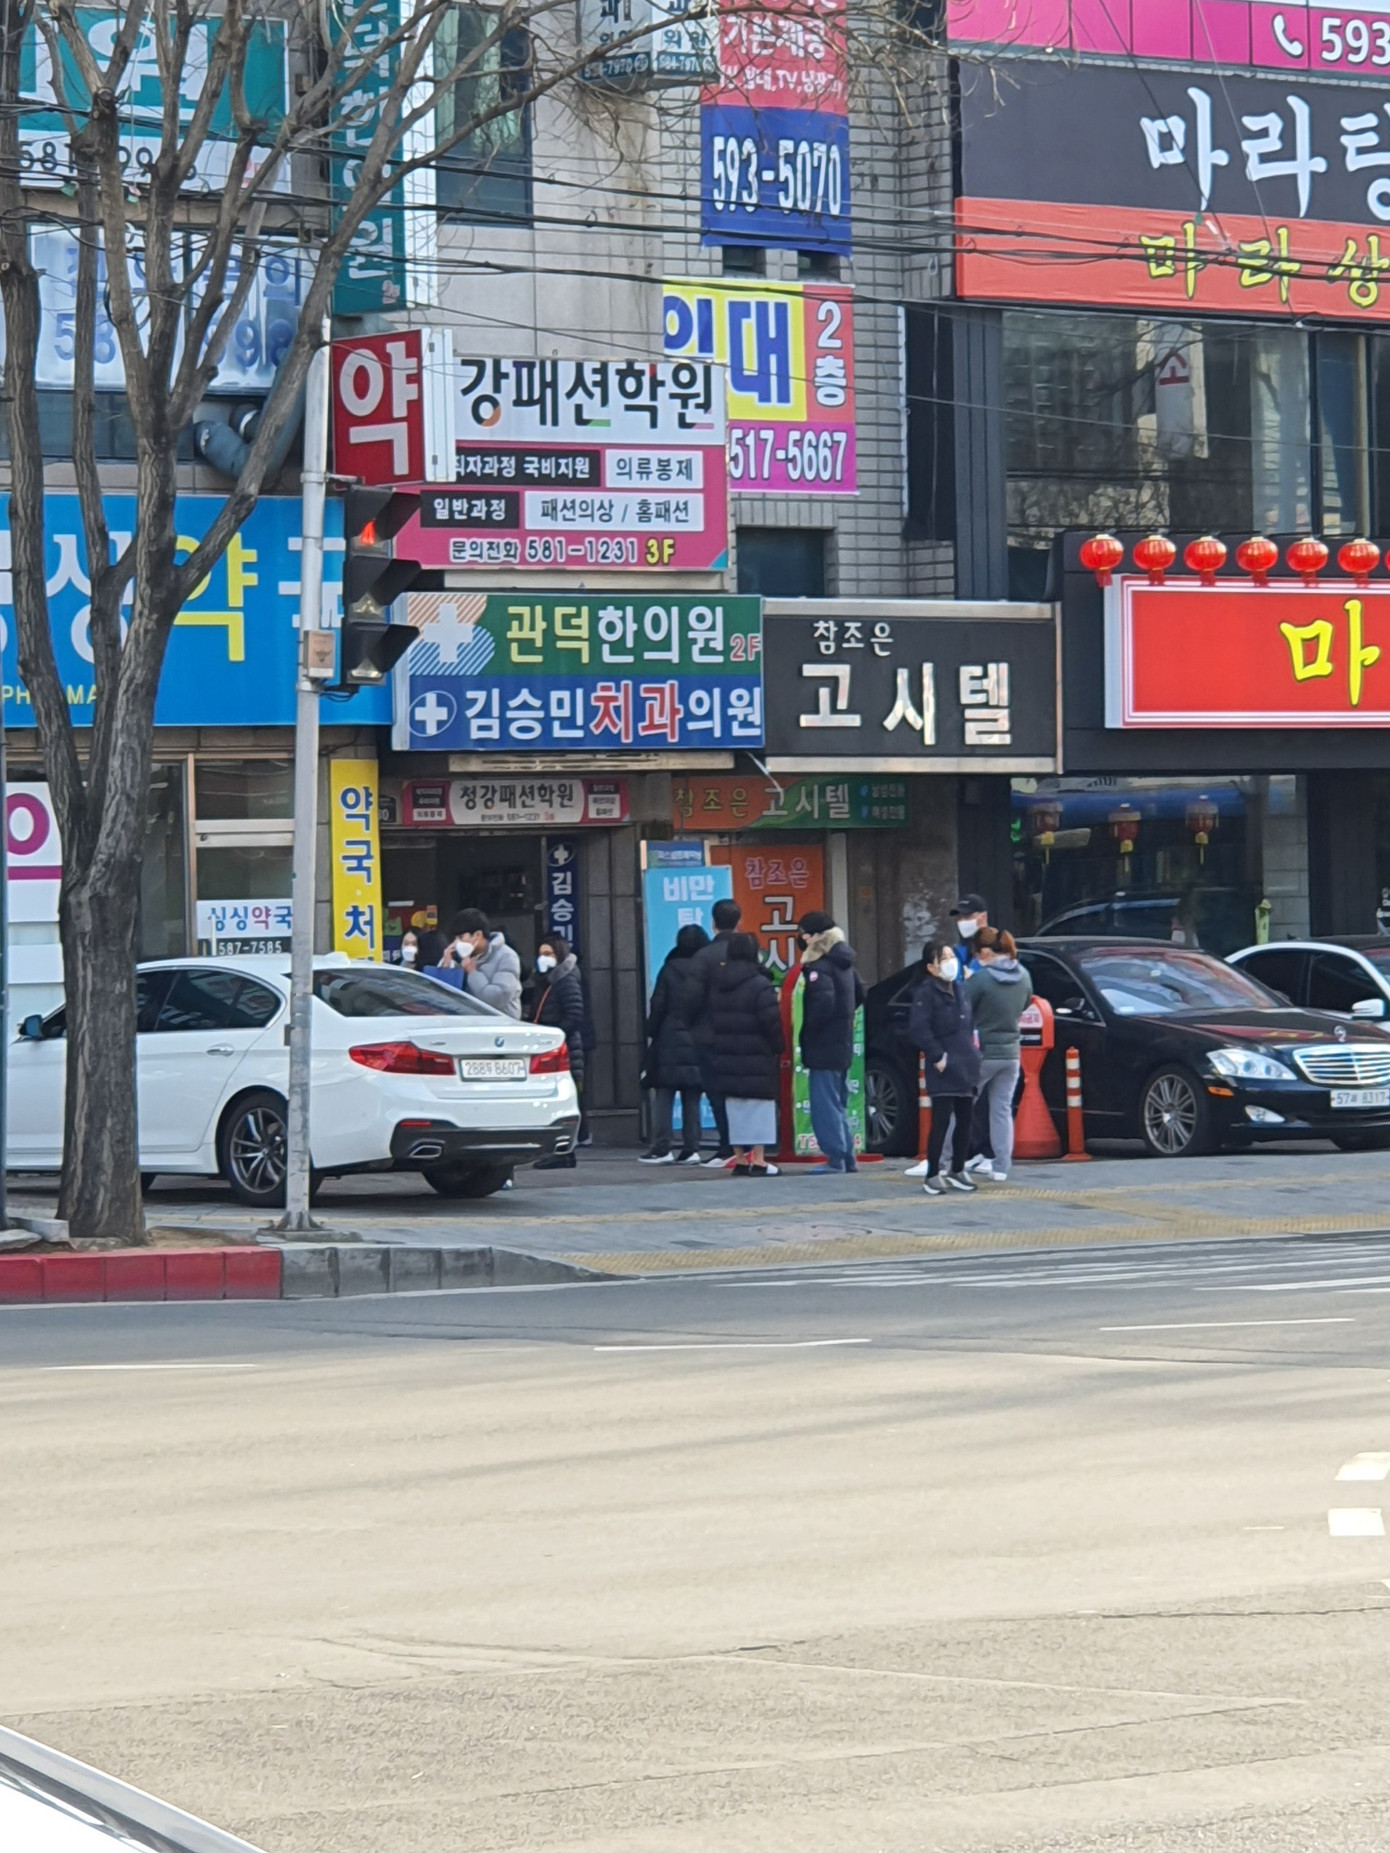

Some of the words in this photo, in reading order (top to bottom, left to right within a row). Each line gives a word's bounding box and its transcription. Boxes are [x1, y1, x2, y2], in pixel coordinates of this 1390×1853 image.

[712, 136, 842, 216] 593-5070
[814, 300, 848, 407] 2층
[339, 341, 419, 476] 약
[523, 456, 590, 479] 국비지원
[615, 457, 694, 482] 의류봉제
[729, 428, 848, 482] 517-5667
[433, 498, 506, 520] 일반과정
[541, 500, 614, 522] 패션의상
[635, 502, 690, 524] 홈패션
[450, 539, 519, 562] 문의전화
[527, 539, 637, 563] 581-1231
[645, 539, 674, 565] 3F
[506, 605, 725, 664] 관덕한의원
[729, 634, 762, 662] 2F
[813, 620, 894, 657] 참조은
[1280, 600, 1381, 706] 마
[464, 680, 762, 743] 김승민치과의원
[800, 662, 1012, 746] 고시텔
[460, 784, 574, 811] 청강패션학원
[675, 788, 749, 818] 참조은
[762, 784, 850, 819] 고시텔
[663, 875, 715, 901] 비만
[745, 857, 810, 890] 참조은
[207, 906, 293, 932] 싱싱약국
